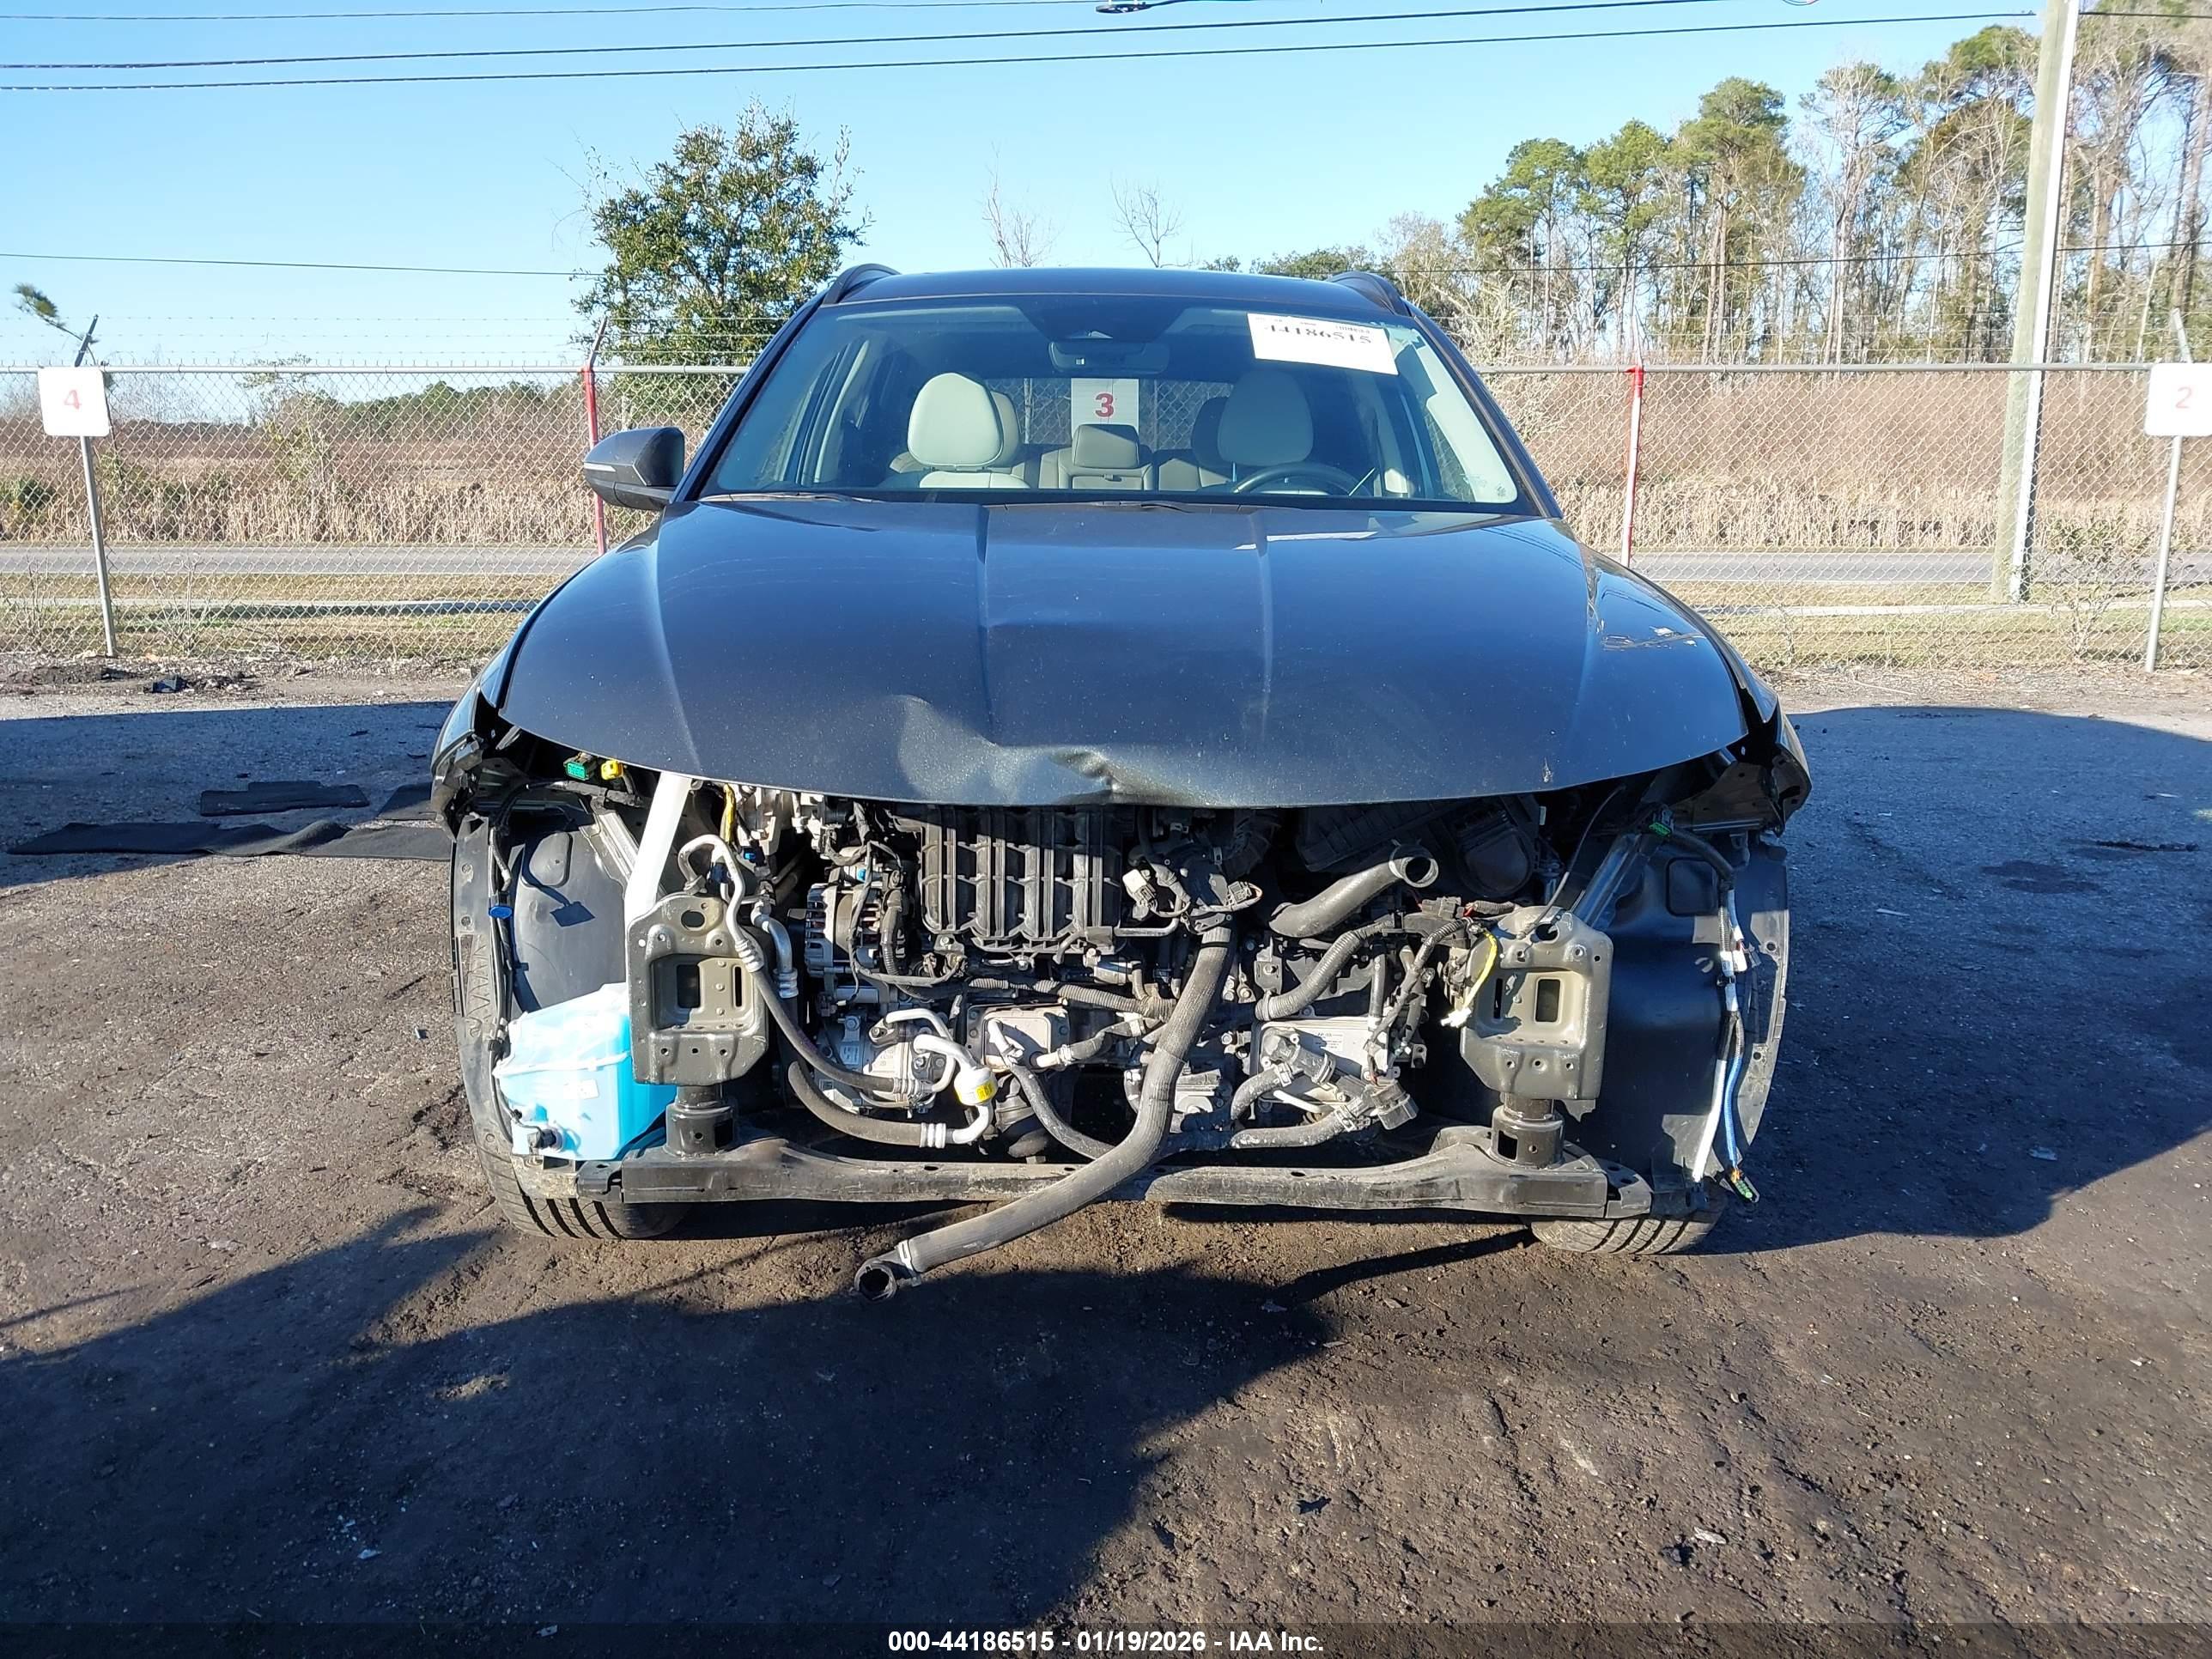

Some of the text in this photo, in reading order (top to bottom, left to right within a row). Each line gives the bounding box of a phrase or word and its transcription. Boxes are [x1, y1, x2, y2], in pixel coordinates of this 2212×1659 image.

[64, 389, 82, 410] 4
[1095, 392, 1115, 417] 3
[2175, 386, 2192, 409] 2
